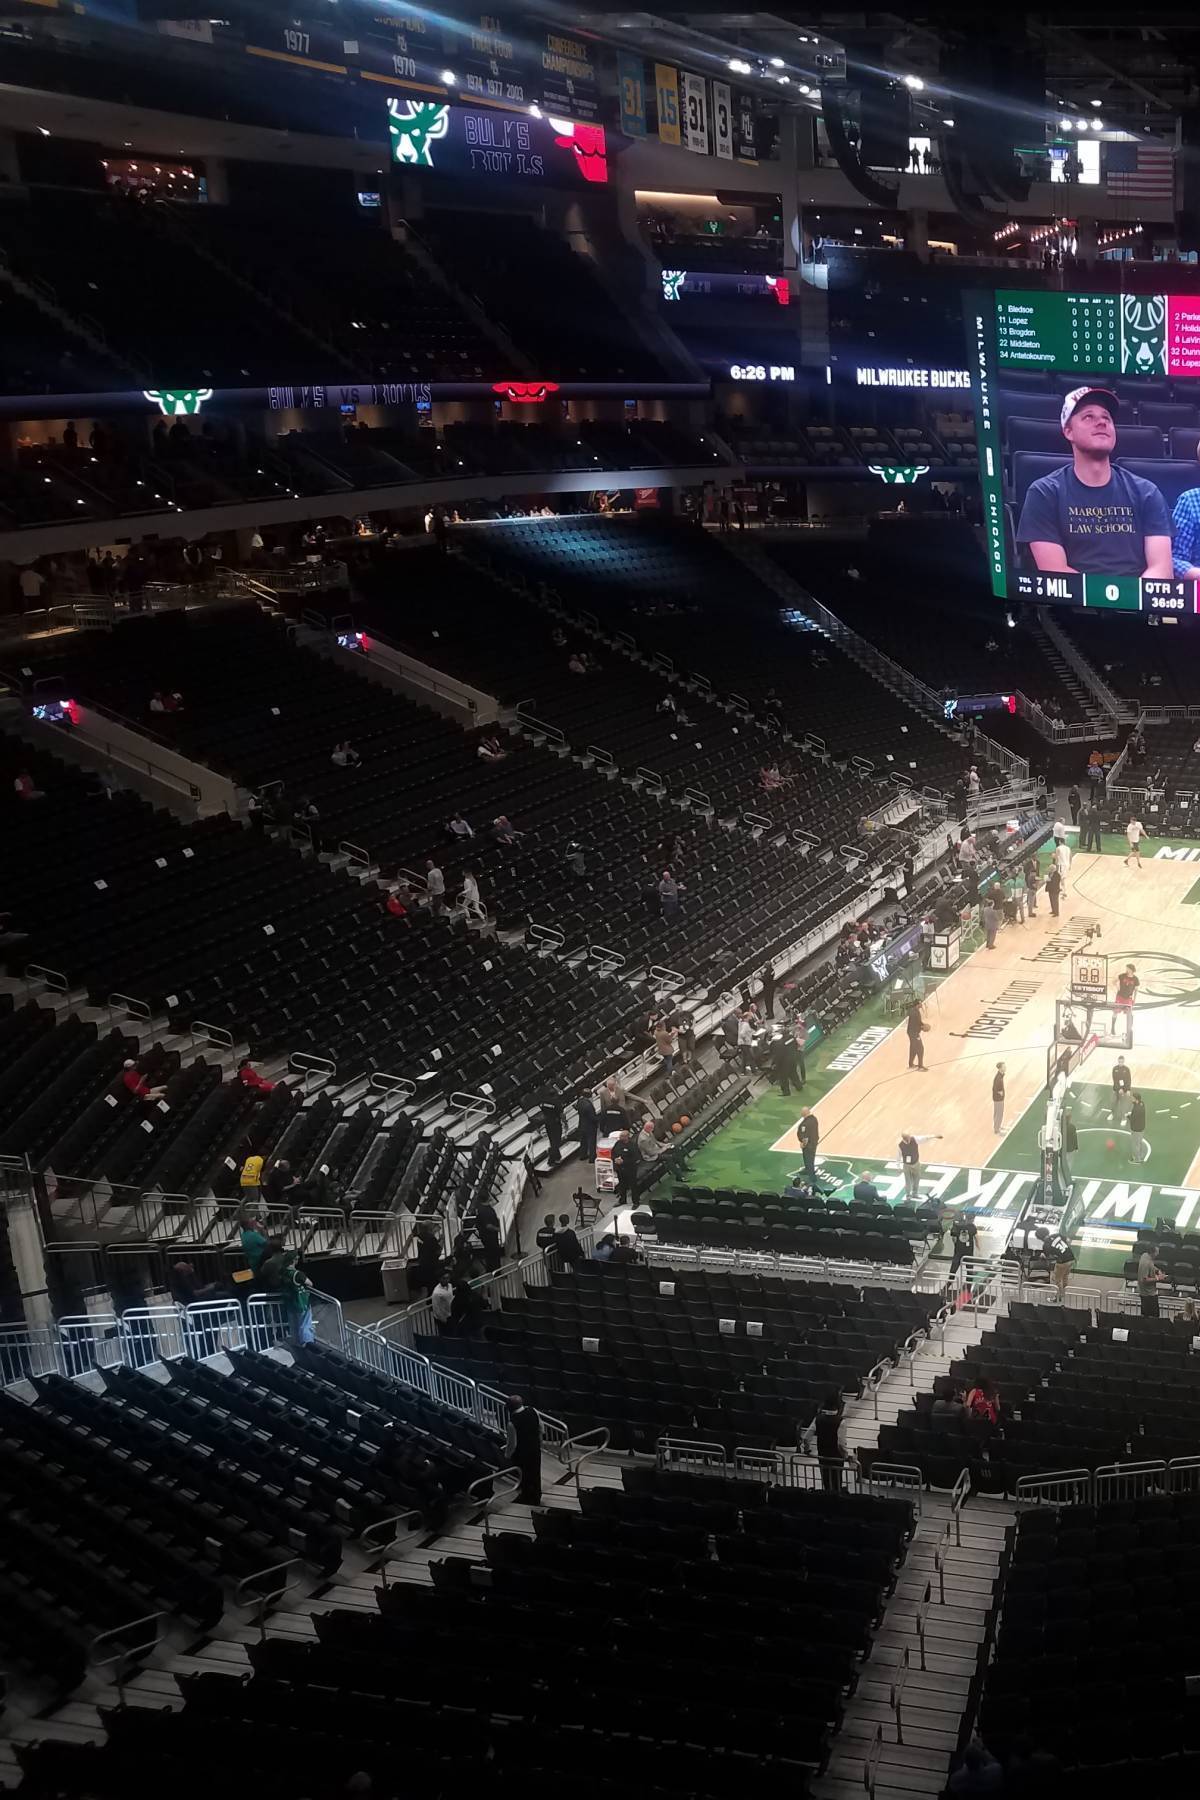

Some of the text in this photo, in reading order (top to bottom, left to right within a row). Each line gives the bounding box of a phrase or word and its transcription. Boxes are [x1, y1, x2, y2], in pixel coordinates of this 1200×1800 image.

[284, 29, 310, 53] 1977
[392, 55, 415, 77] 1970
[659, 88, 677, 125] 15
[689, 96, 705, 133] 31
[719, 104, 728, 138] 3
[1008, 317, 1028, 325] Lopez
[1009, 328, 1036, 337] Brogdon
[1010, 340, 1040, 349] Middleton
[730, 366, 794, 380] 6:26 PM
[857, 368, 971, 388] MILWAUKEE BUCKS
[976, 317, 991, 430] MILWAUKEE
[339, 388, 359, 401] VS
[1069, 507, 1133, 518] MARQUETTE
[990, 494, 1001, 573] CHICAGO
[1069, 524, 1136, 534] LAW SCHOOL
[1036, 577, 1043, 585] 7
[1046, 578, 1072, 598] MIL
[1145, 583, 1184, 594] QTR 1
[1105, 584, 1119, 600] 0
[1152, 598, 1184, 609] 36:05
[814, 1166, 844, 1186] BUCK
